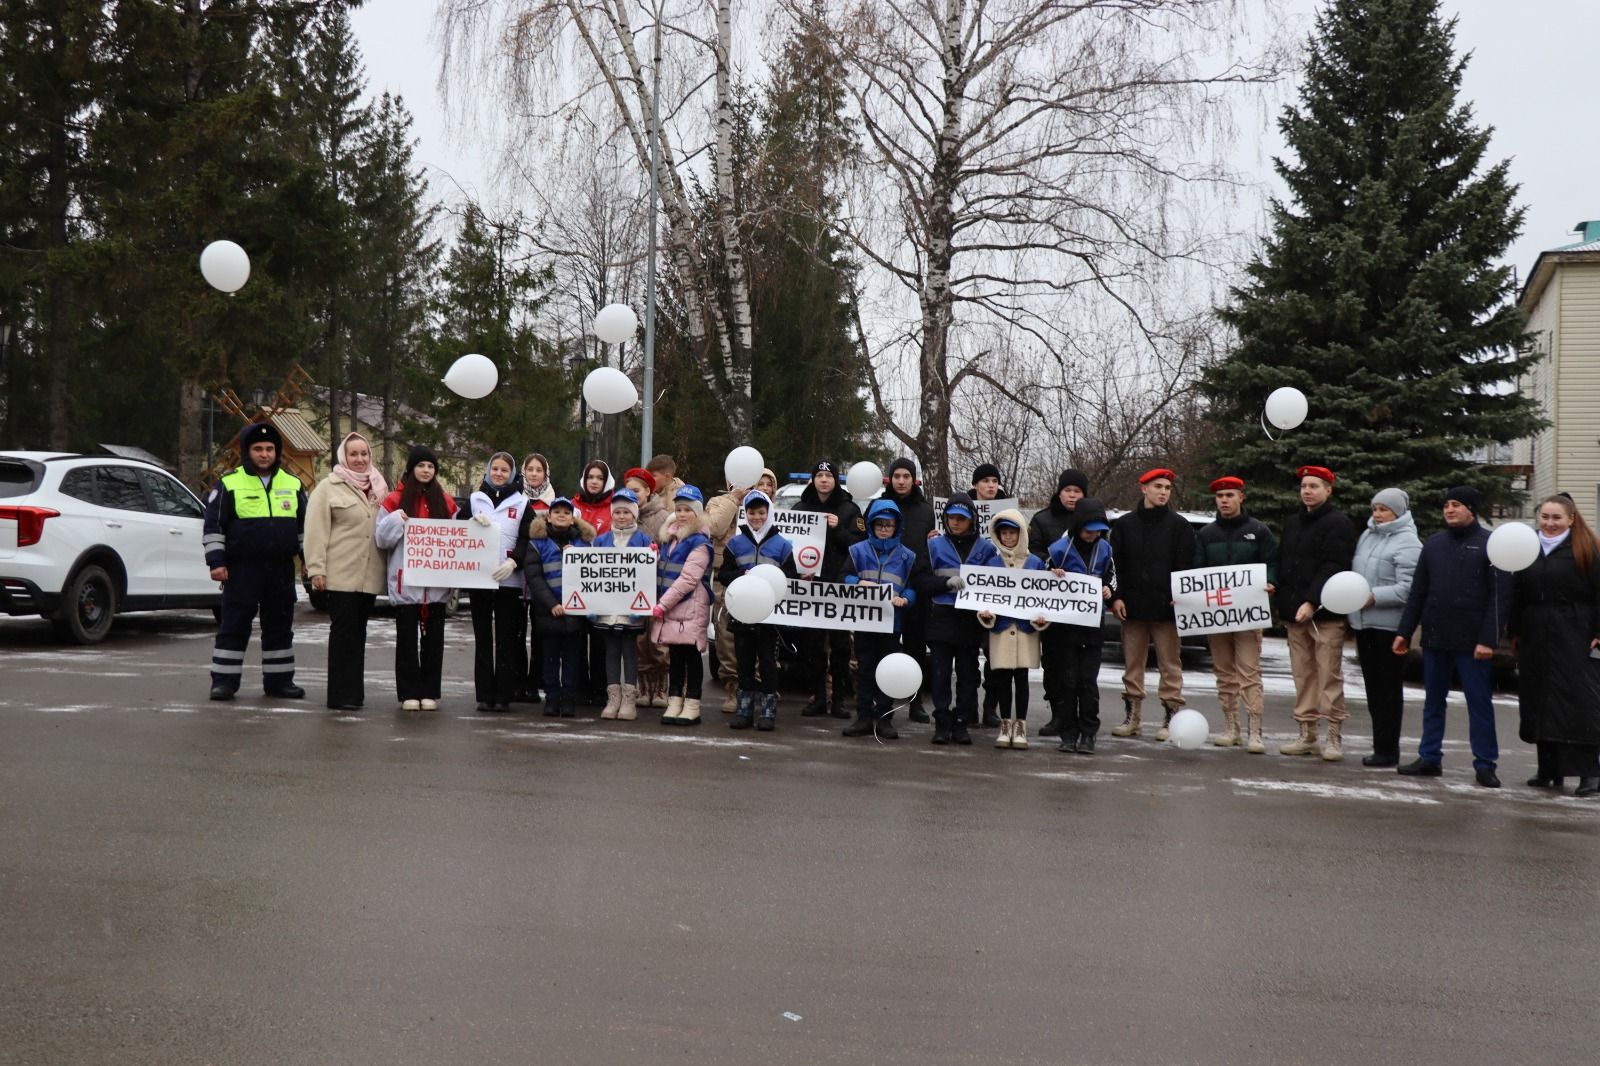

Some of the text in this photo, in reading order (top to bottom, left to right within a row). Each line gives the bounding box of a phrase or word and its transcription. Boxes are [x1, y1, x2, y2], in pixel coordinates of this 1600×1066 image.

[407, 525, 468, 536] ДВИЖЕНИЕ
[778, 526, 811, 536] ТЕЛЬ!
[407, 547, 456, 558] ОНО ПО
[565, 553, 655, 564] ПРИСТЕГНИСЬ
[407, 559, 480, 571] ПРАВИЛАМ!
[580, 567, 636, 578] ВЫБЕРИ
[580, 581, 636, 593] ЖИЗНЬ!
[966, 573, 1098, 595] СБАВЬ СКОРОСТЬ
[1179, 570, 1253, 594] ВЫПИЛ
[810, 581, 892, 601] ПАМЯТИ
[1205, 587, 1233, 607] НЕ
[959, 591, 1098, 614] И ТЕБЯ ДОЖДУТСЯ
[840, 604, 883, 623] ДТП
[1177, 605, 1271, 631] ЗАВОДИСЬ
